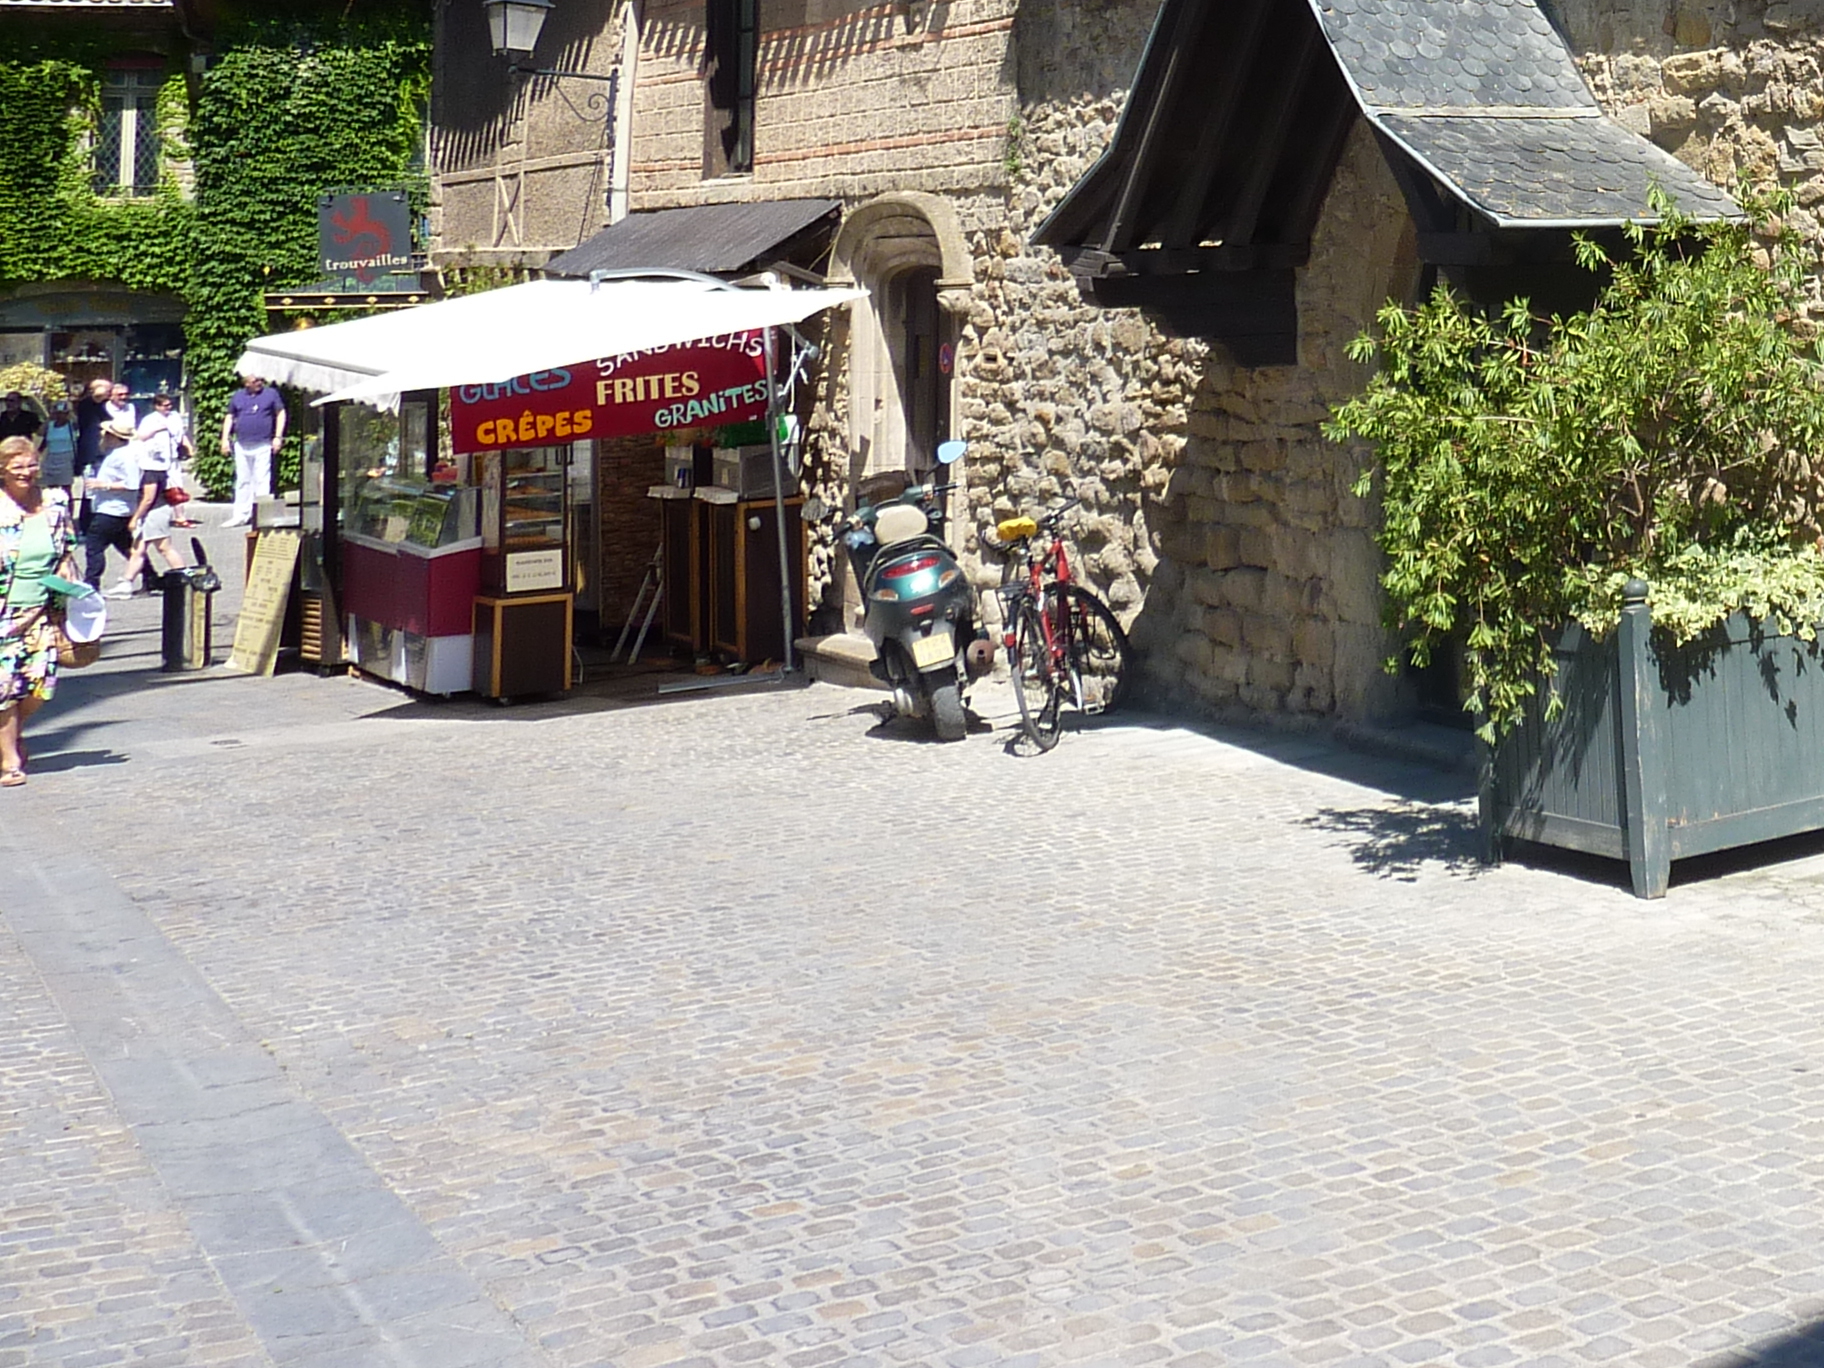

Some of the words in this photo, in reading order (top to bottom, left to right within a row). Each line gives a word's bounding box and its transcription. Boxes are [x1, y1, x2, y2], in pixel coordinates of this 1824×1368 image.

[325, 253, 408, 271] trouvailles
[596, 371, 700, 406] FRITES
[476, 409, 593, 445] CRÊPES
